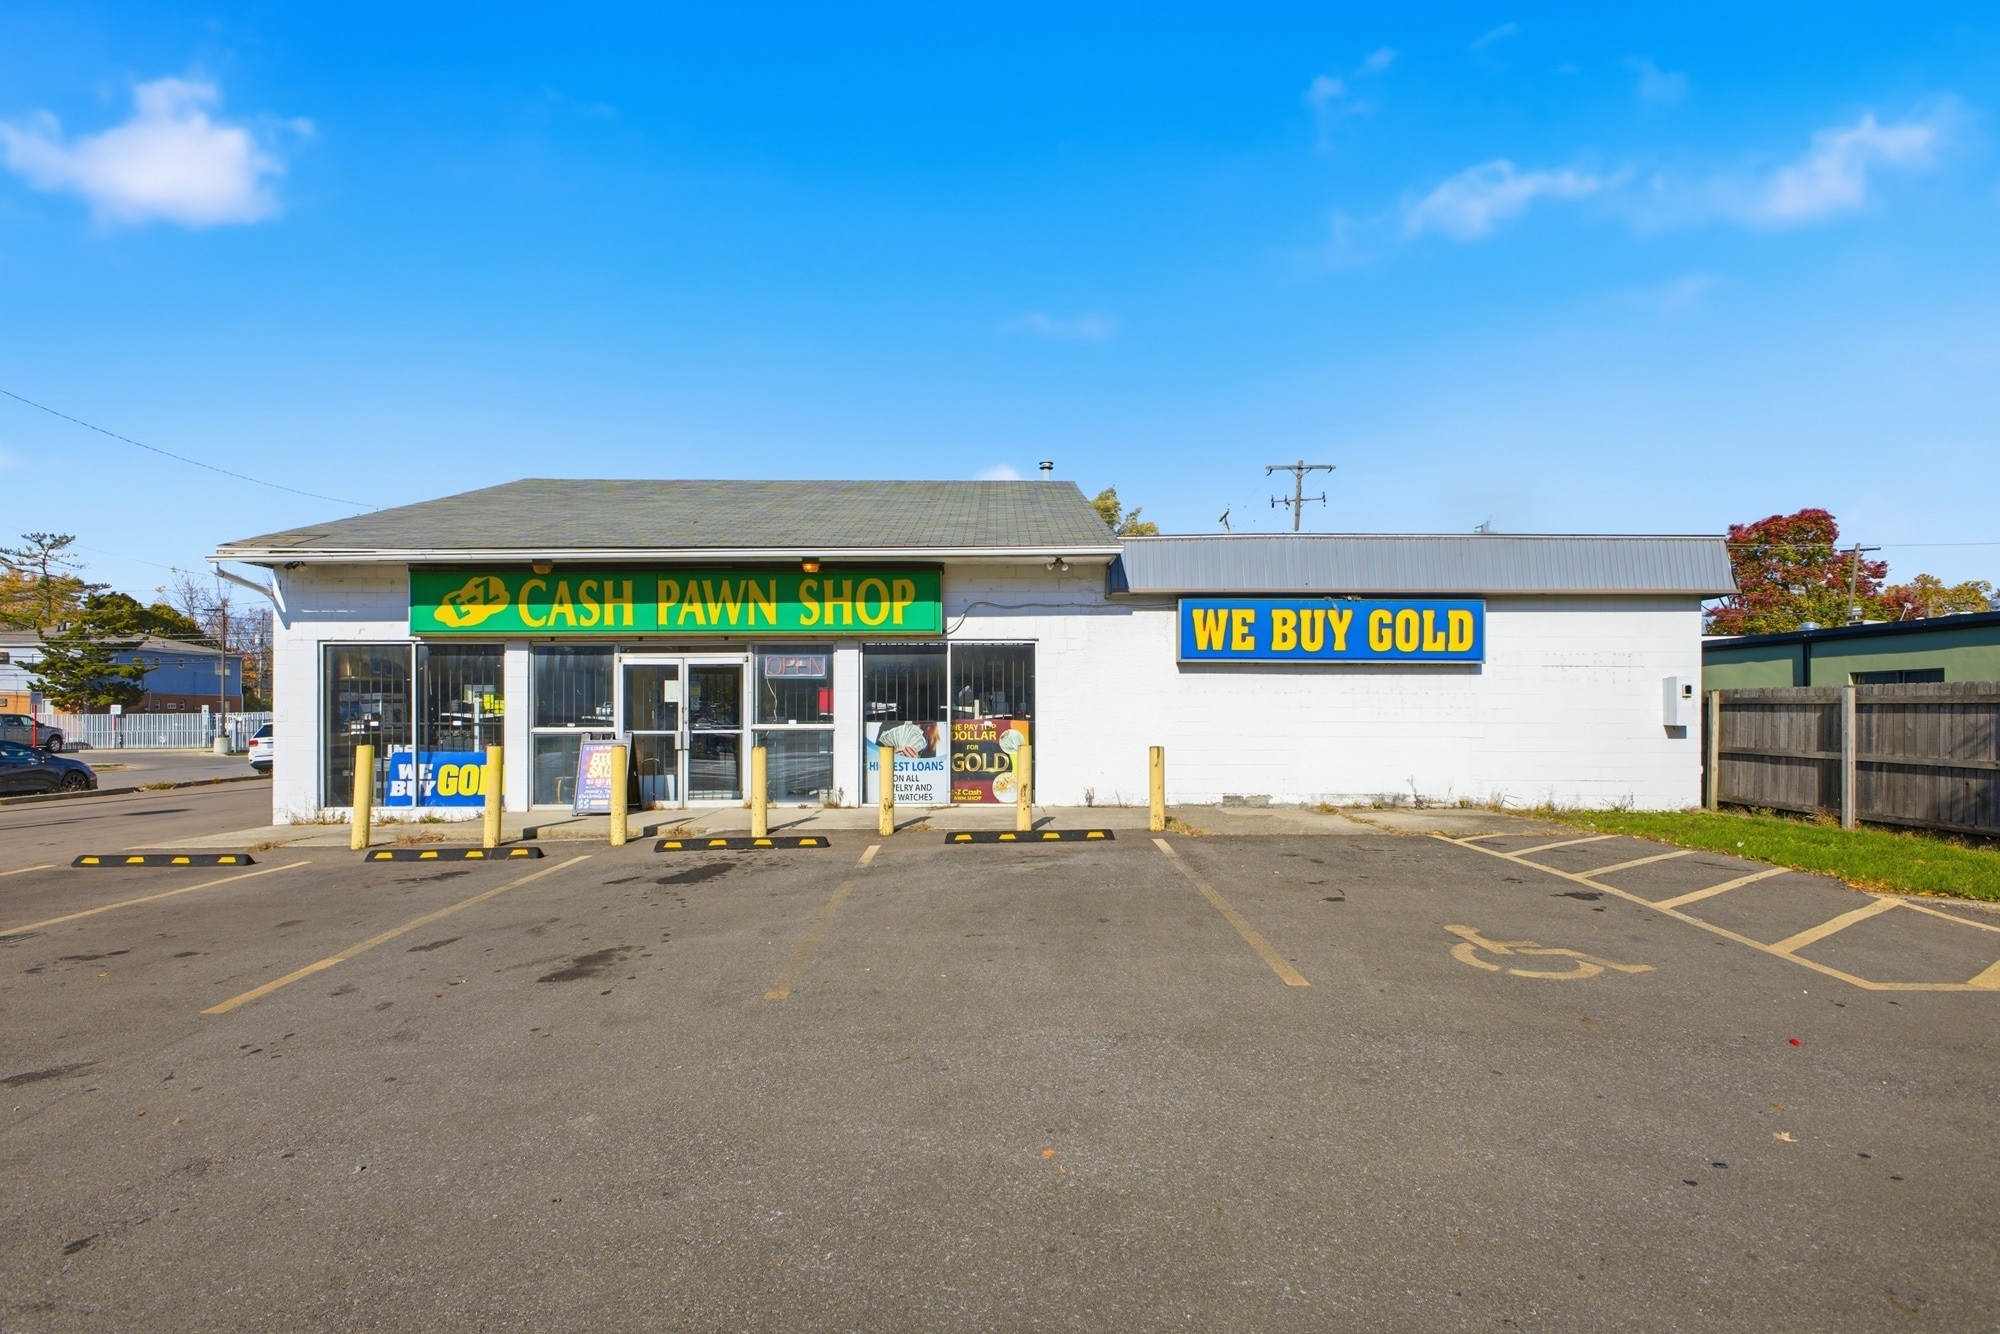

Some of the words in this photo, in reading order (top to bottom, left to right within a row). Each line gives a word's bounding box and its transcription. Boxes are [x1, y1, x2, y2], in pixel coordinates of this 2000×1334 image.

[448, 578, 500, 620] E-Z
[518, 578, 634, 628] CASH
[657, 578, 777, 626] PAWN
[799, 577, 916, 627] SHOP
[1191, 608, 1256, 651] WE
[1271, 608, 1353, 652] BUY
[1368, 608, 1475, 653] GOLD
[766, 655, 825, 676] OPEN
[964, 723, 978, 731] PAY
[869, 761, 910, 771] HIEST
[912, 761, 944, 771] LOANS
[951, 752, 1010, 772] GOLD
[397, 763, 434, 780] WE
[893, 774, 904, 782] ON
[905, 774, 920, 782] ALL
[897, 793, 933, 801] WATCHES
[962, 788, 982, 796] Cash
